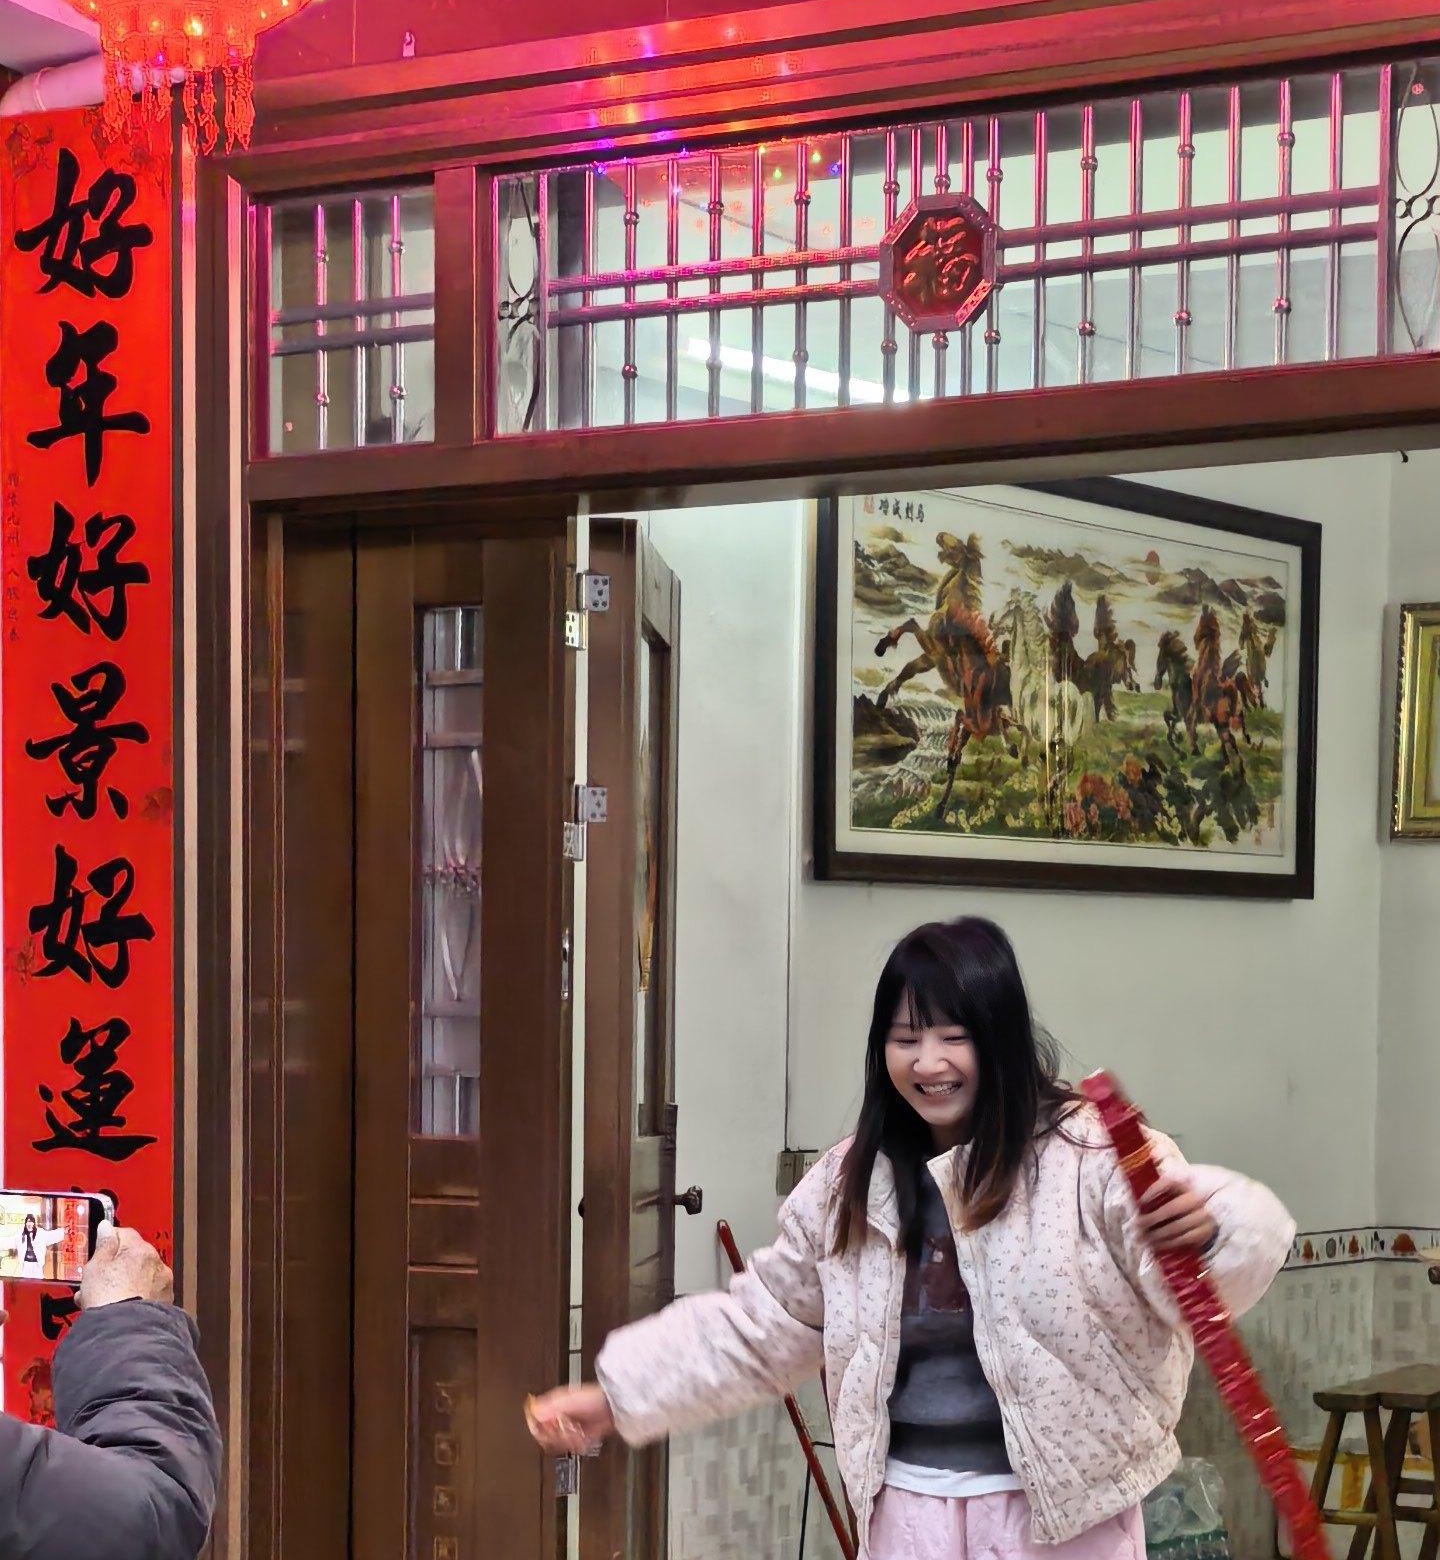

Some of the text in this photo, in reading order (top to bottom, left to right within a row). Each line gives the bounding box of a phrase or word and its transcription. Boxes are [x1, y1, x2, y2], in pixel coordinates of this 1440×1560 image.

[15, 147, 157, 1340] 好年好景好運
